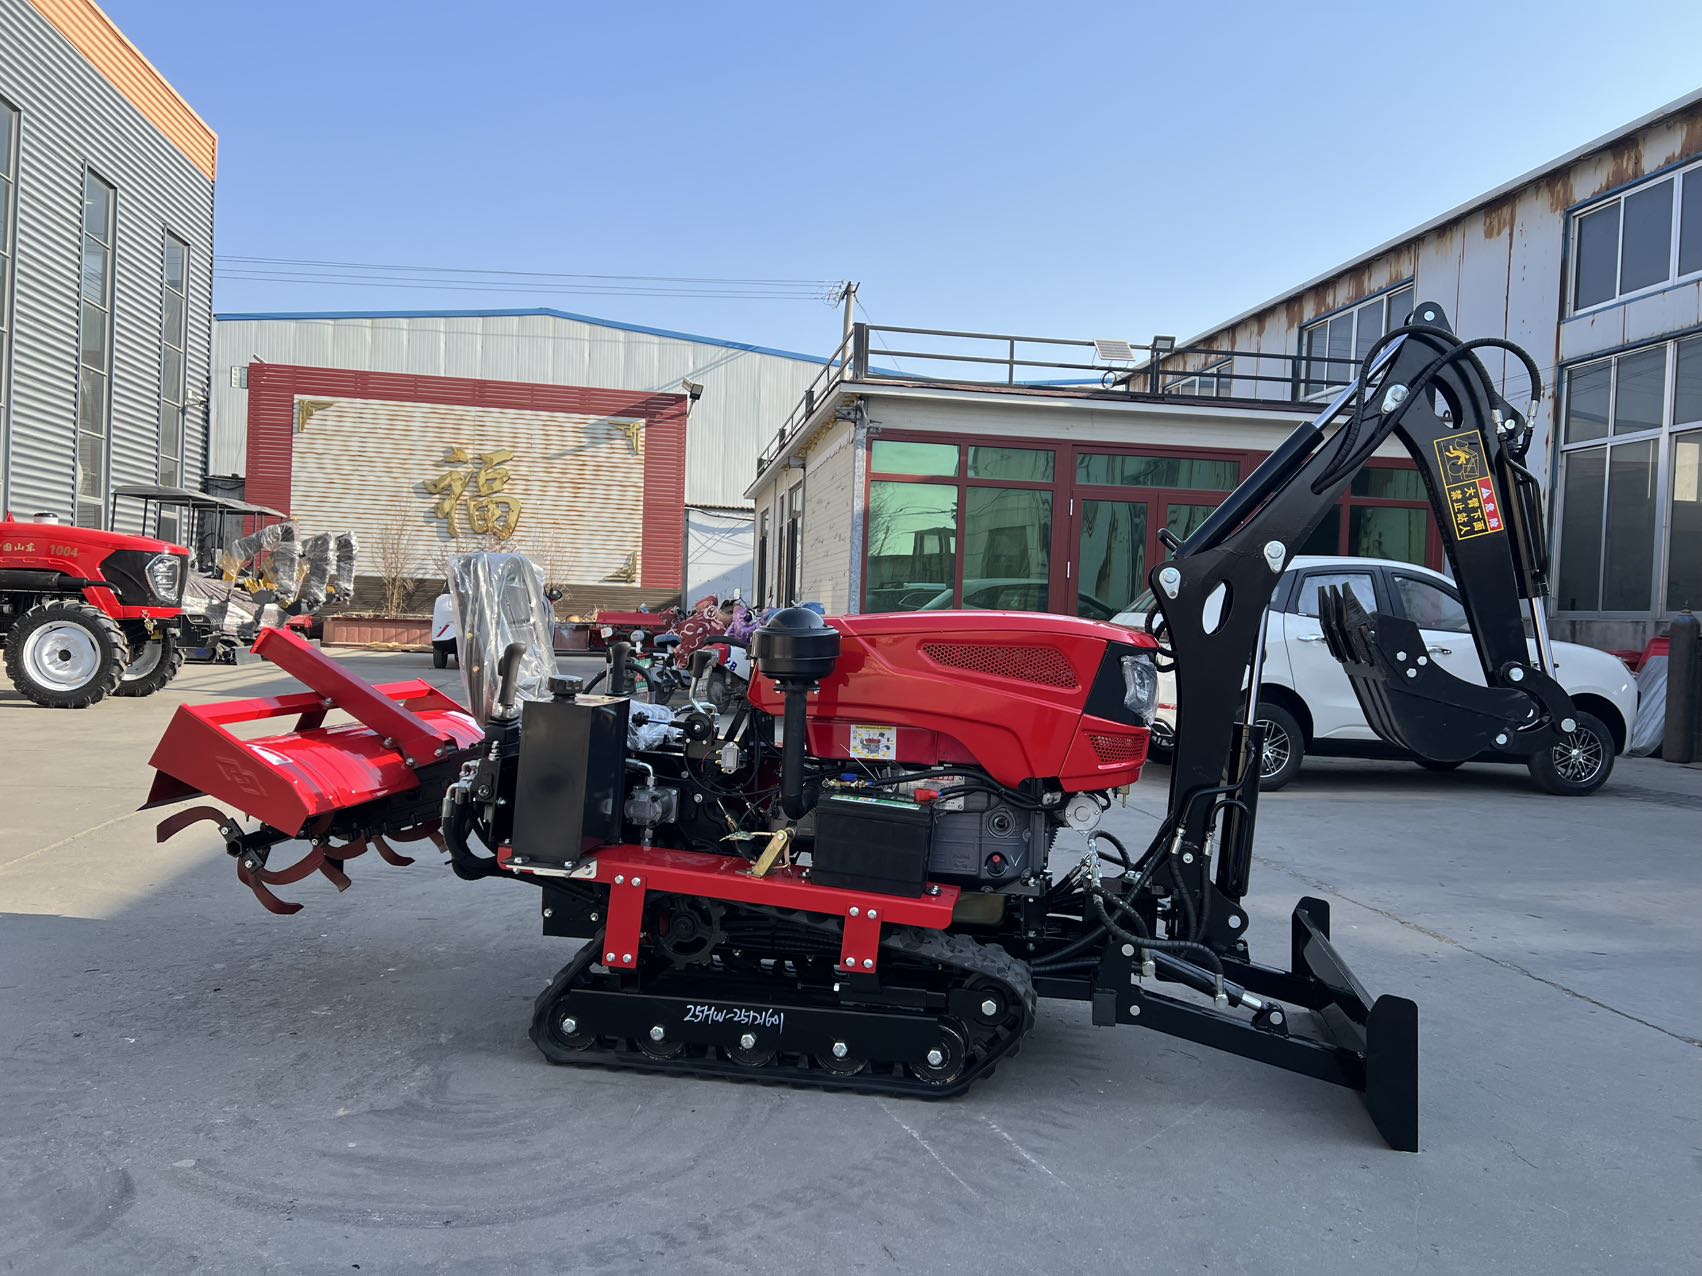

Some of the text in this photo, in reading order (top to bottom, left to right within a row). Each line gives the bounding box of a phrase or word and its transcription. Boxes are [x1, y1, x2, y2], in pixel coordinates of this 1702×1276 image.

[422, 446, 521, 541] 福
[1450, 489, 1471, 535] 禁止站人
[1464, 486, 1485, 531] 大臂下面
[49, 544, 79, 558] 1004
